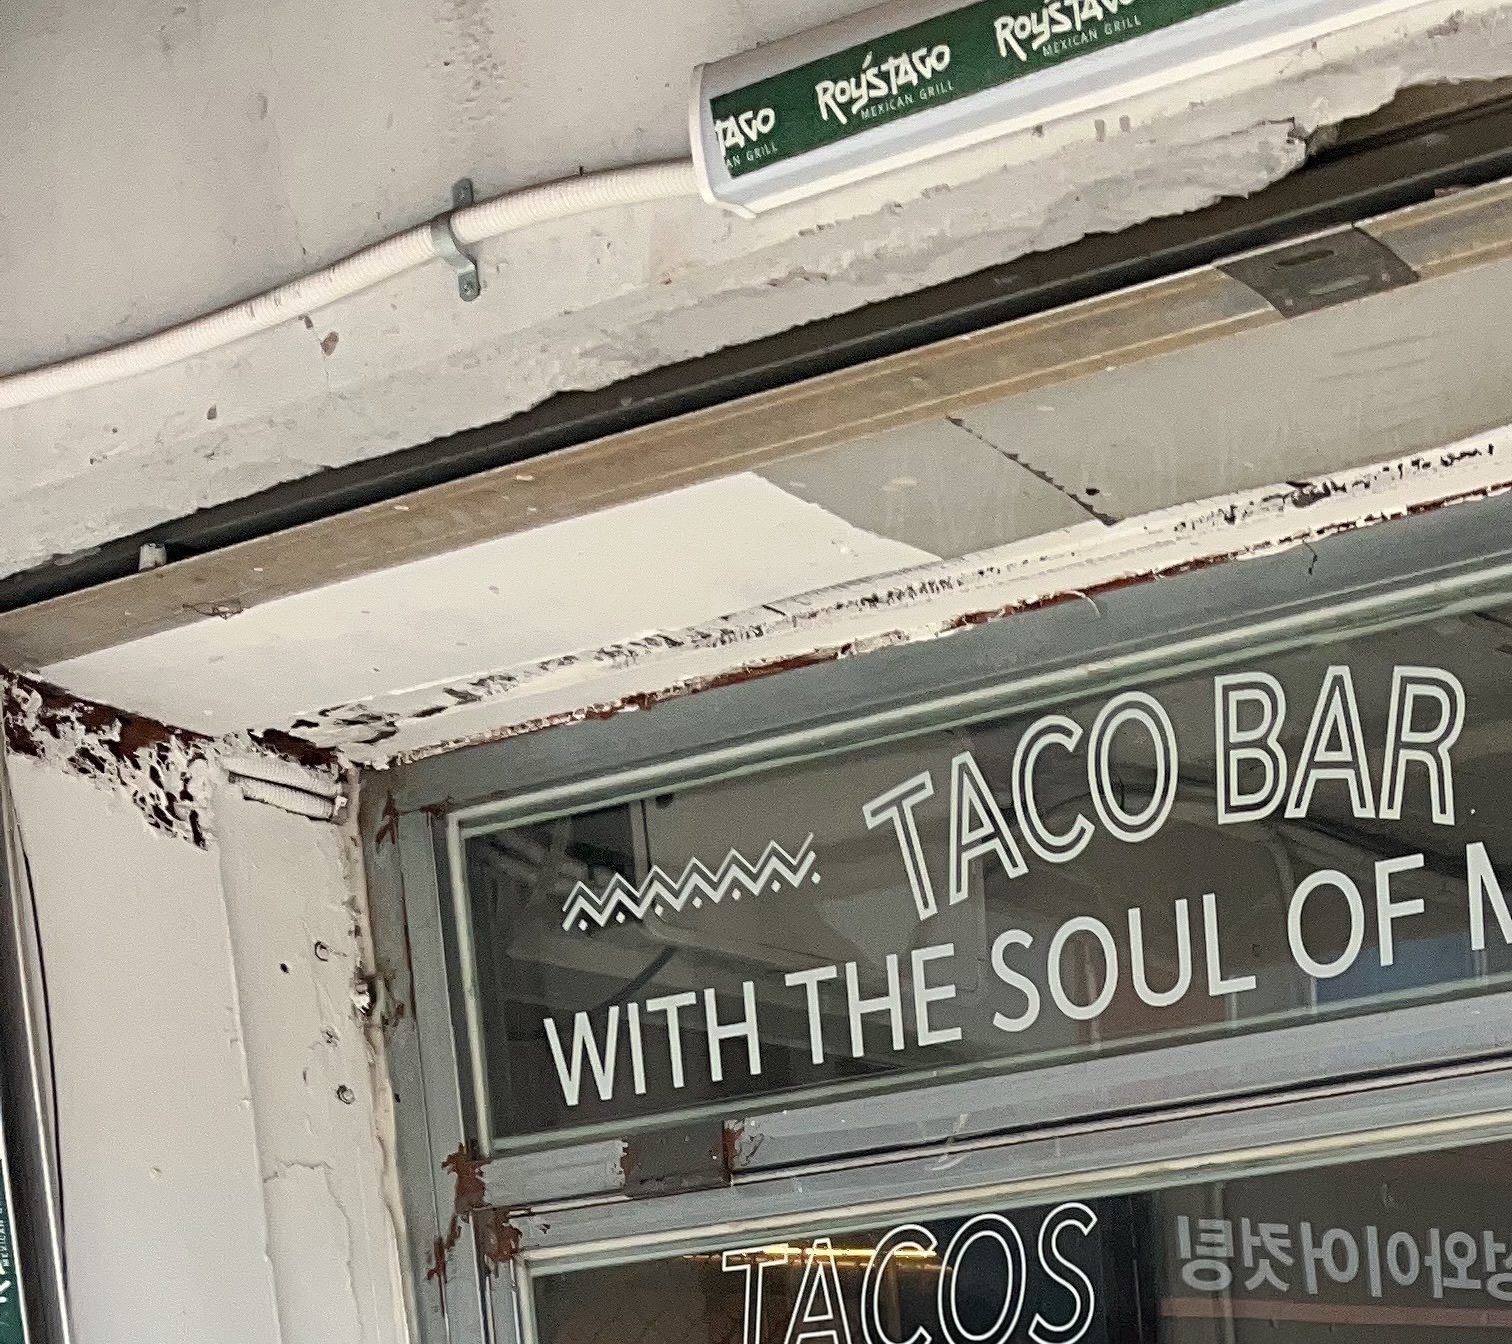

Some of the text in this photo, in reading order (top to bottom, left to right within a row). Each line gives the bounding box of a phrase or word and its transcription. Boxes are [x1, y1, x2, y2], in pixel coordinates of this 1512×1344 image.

[1042, 14, 1142, 57] MEXICAN GRILL
[861, 79, 955, 120] MEXICAN GRILL
[746, 140, 778, 162] GRILL
[863, 664, 1467, 921] TACO BAR
[542, 985, 762, 1108] WITH
[786, 940, 963, 1067] THE
[992, 892, 1257, 1036] SOUL
[1287, 852, 1427, 981] OF
